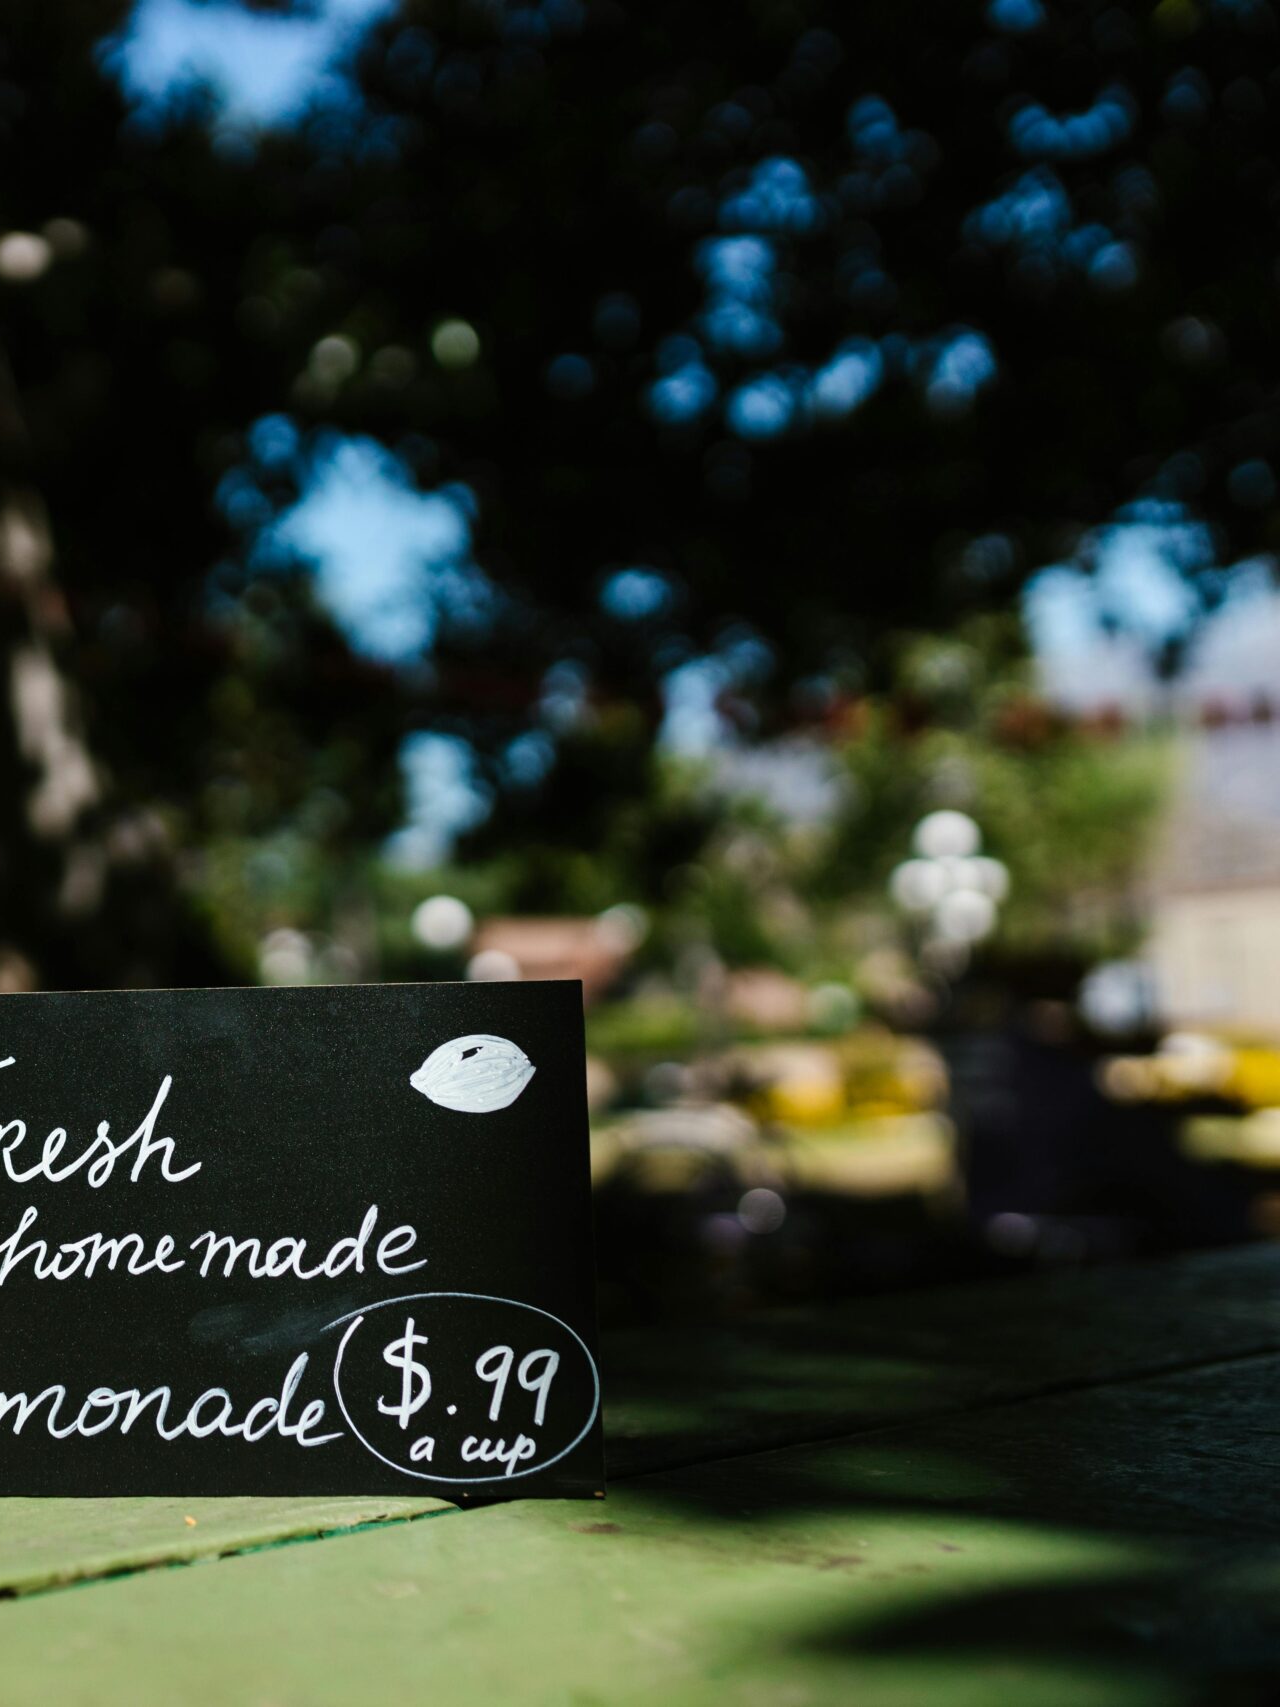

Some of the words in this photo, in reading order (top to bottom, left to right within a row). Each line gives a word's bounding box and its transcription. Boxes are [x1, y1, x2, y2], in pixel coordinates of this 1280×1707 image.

[377, 1316, 560, 1430] $.99
[409, 1435, 435, 1462] a
[460, 1433, 537, 1476] cup
